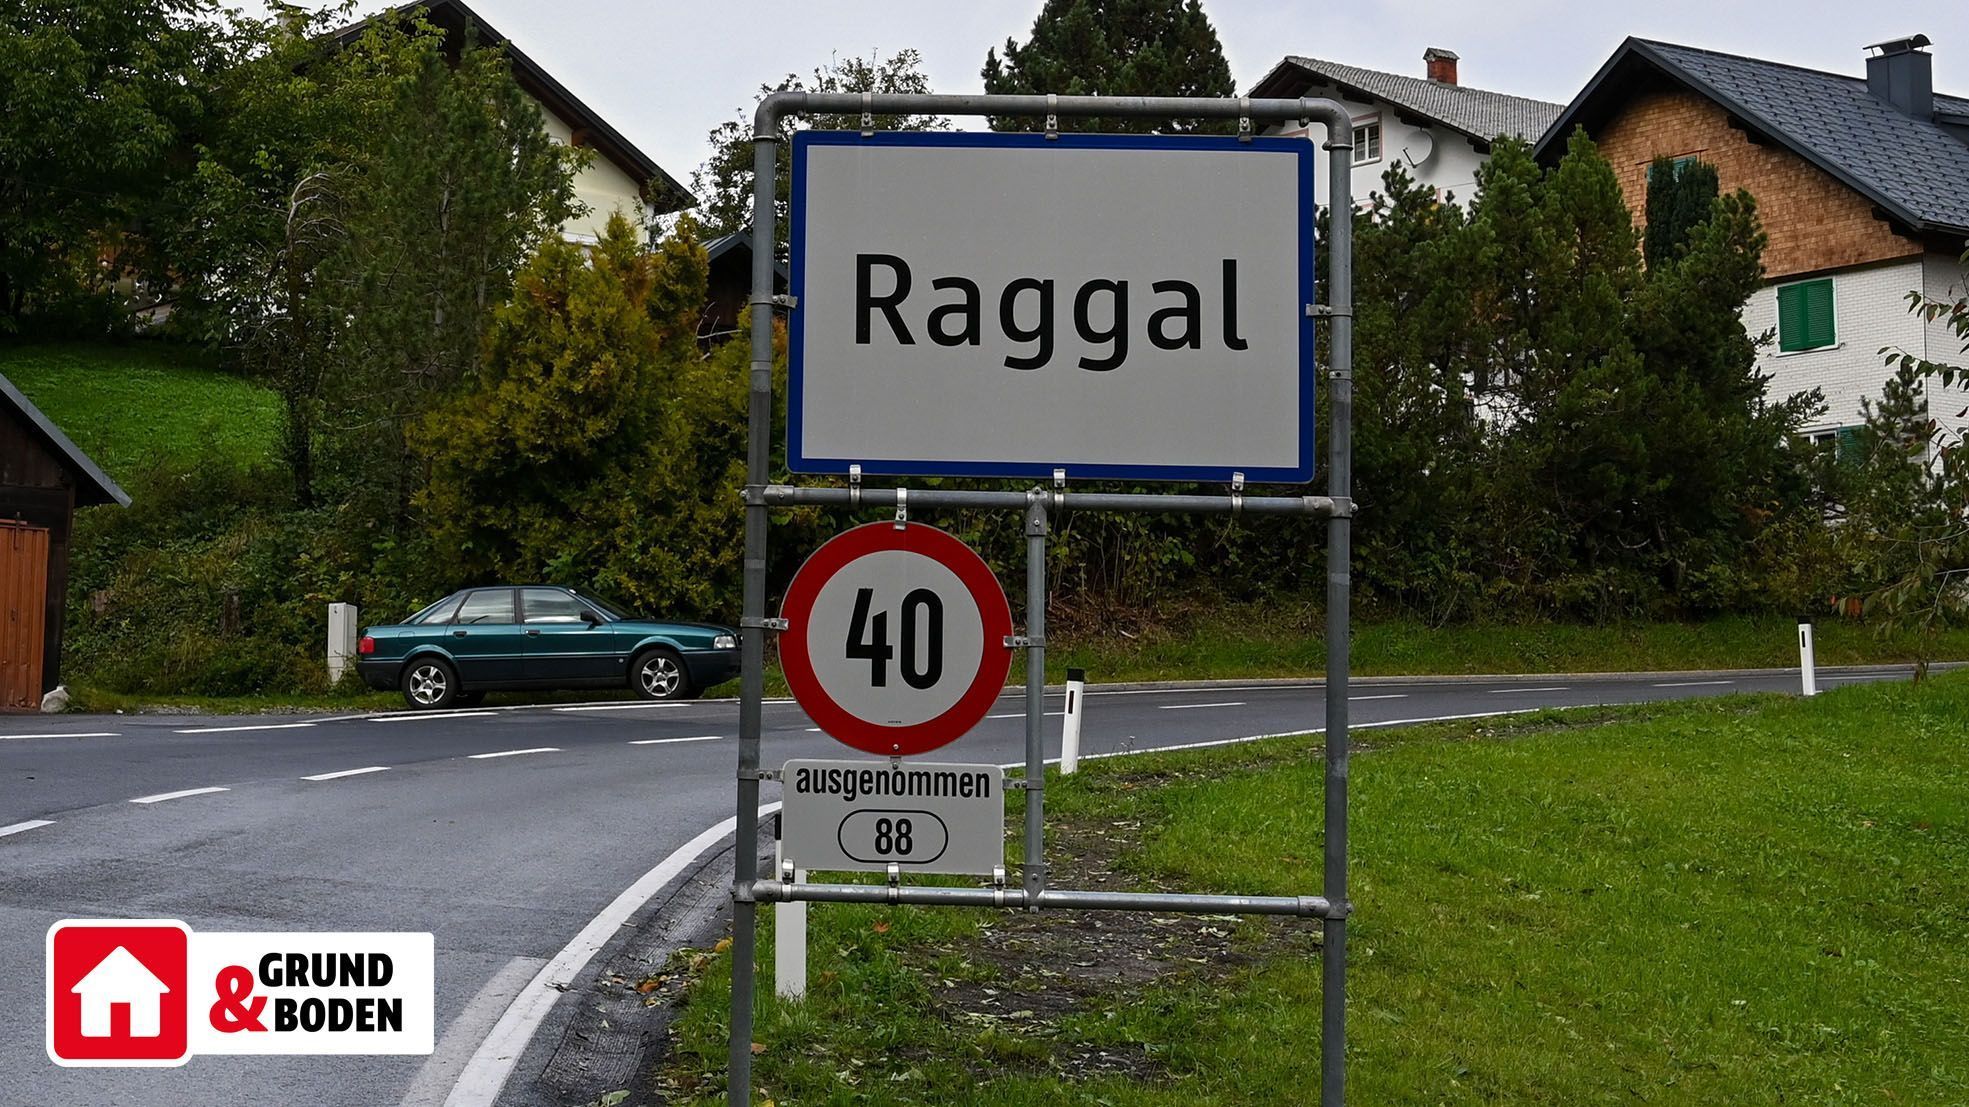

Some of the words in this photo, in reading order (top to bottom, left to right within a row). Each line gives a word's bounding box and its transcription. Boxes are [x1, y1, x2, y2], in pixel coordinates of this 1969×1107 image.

[855, 253, 1249, 372] Raggal
[845, 588, 944, 690] 40
[796, 767, 991, 802] ausgenommen
[874, 818, 913, 856] 88
